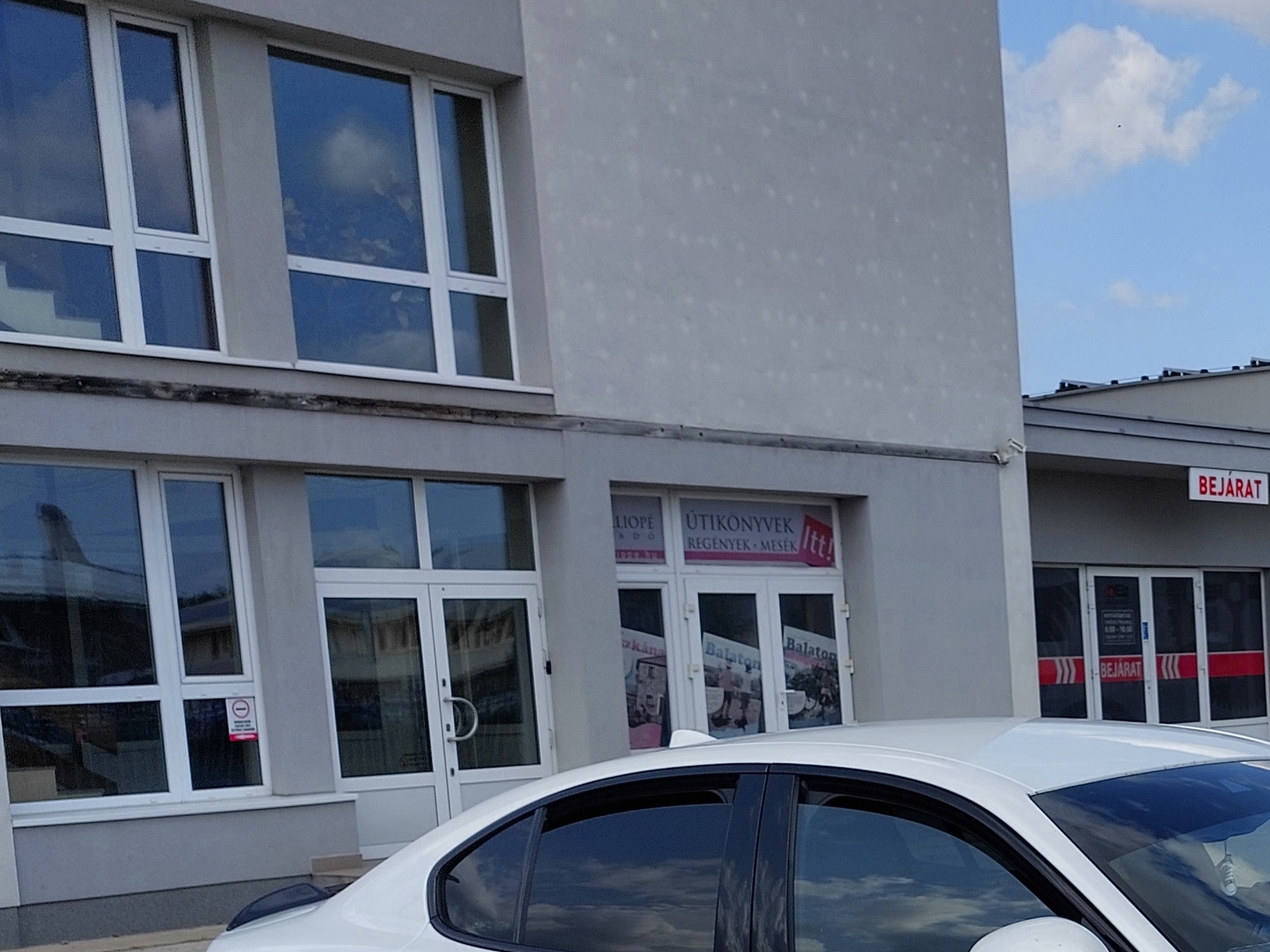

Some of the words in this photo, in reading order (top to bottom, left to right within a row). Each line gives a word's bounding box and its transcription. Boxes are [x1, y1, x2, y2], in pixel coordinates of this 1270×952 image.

[1199, 471, 1262, 499] BEJÁRAT
[685, 510, 795, 534] ÚTIKÖNYVEK
[688, 535, 750, 551] REGÉNYEK
[761, 538, 798, 553] MESÉK
[803, 525, 834, 561] Itt!
[705, 641, 761, 670] Balaton
[785, 637, 838, 661] Balaton
[1101, 659, 1142, 679] BEJÁRAT
